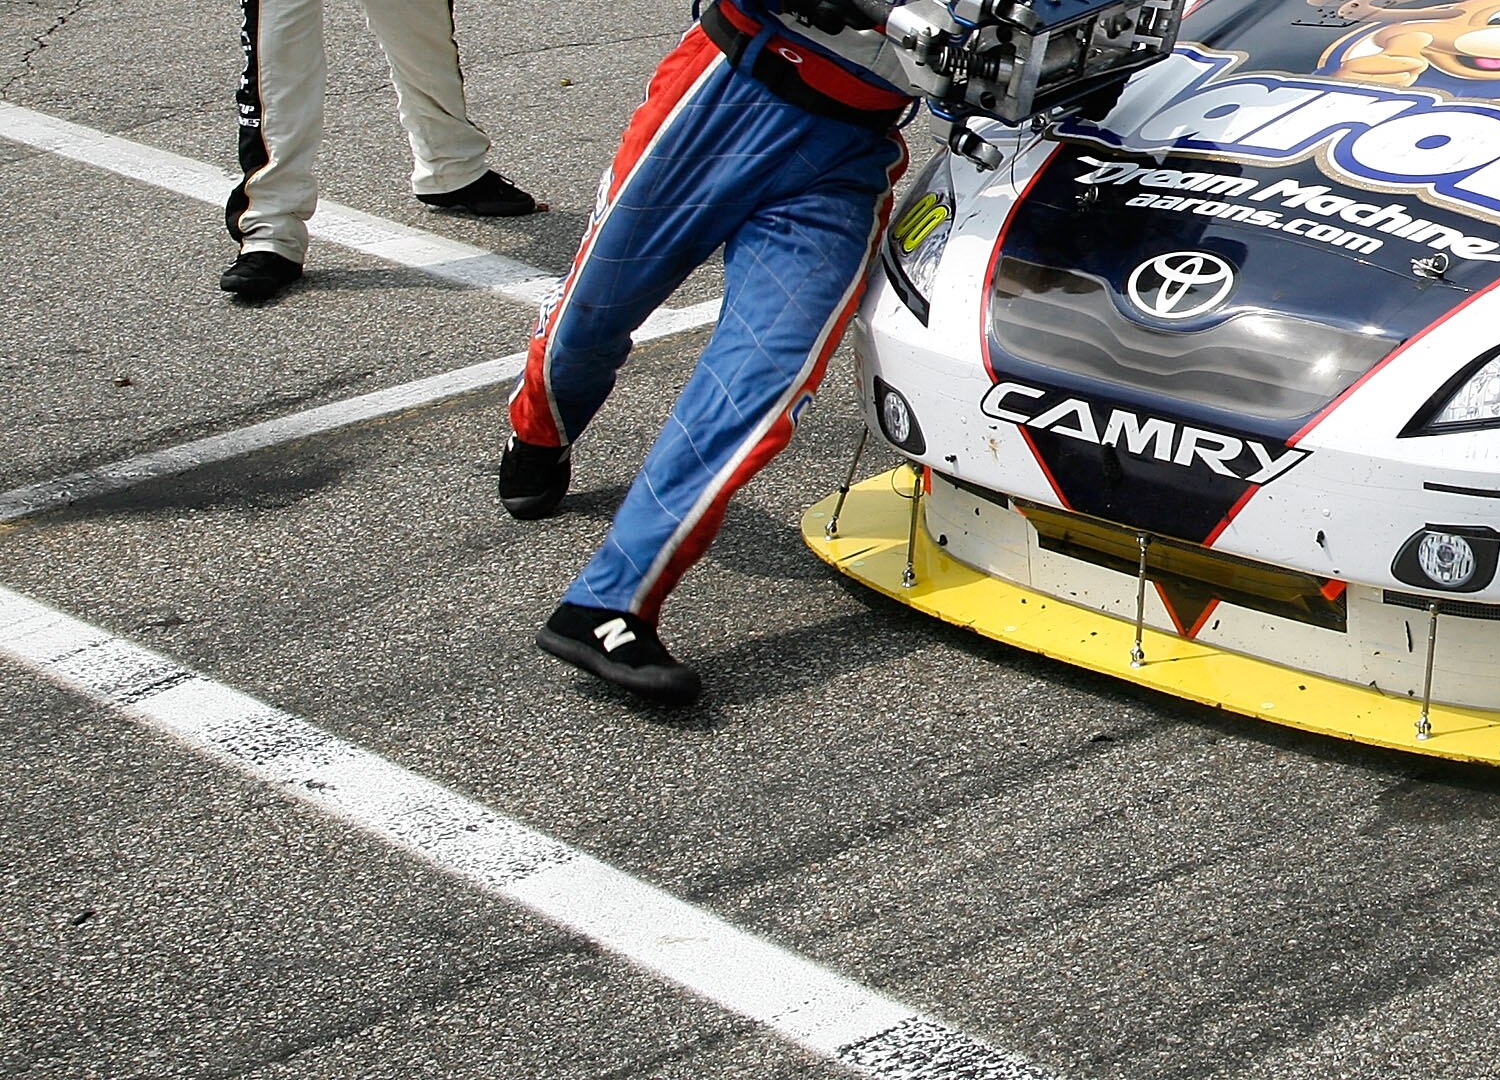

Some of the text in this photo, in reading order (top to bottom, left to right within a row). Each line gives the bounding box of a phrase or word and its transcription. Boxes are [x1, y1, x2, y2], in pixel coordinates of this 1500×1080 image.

[1076, 155, 1260, 197] Dream
[894, 191, 950, 253] 00
[1126, 193, 1385, 255] aarons.com
[982, 382, 1306, 484] CAMRY
[594, 617, 636, 652] N
